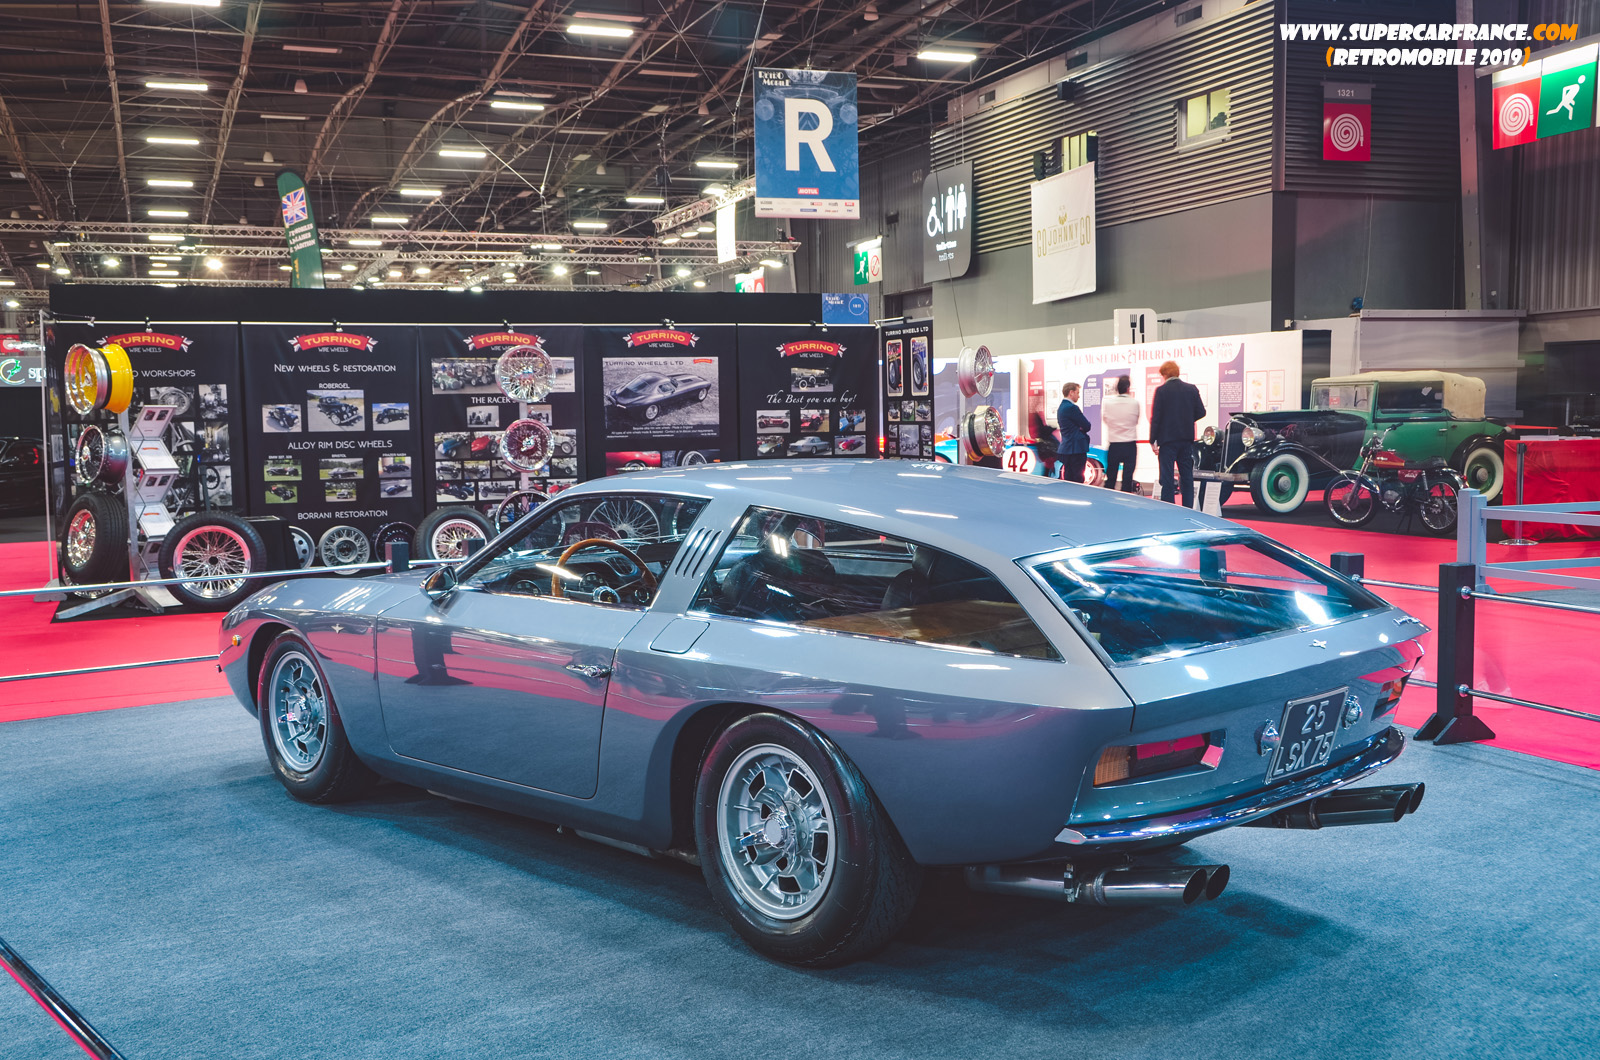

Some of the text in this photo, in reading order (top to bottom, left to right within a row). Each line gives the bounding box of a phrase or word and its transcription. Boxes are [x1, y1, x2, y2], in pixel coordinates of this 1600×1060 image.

[1337, 89, 1355, 97] 1321
[784, 98, 837, 172] R
[1036, 215, 1091, 258] GO JOHNNY GO
[636, 332, 686, 342] TURRINO
[885, 329, 901, 337] TURRINO
[902, 327, 920, 335] WHEELS
[114, 335, 175, 346] TURRINO
[304, 335, 361, 346] TURRINO
[478, 335, 531, 345] TURRINO
[789, 343, 834, 352] TURRINO
[1188, 345, 1214, 358] MANS
[141, 369, 196, 377] WORKSHOPS
[332, 364, 340, 372] &
[343, 364, 397, 372] RESTORATION
[766, 389, 784, 403] The
[785, 393, 804, 403] Best
[800, 398, 820, 409] you
[840, 389, 857, 409] buy!
[287, 440, 393, 450] ALLOY RIM DISC WHEELS
[1008, 451, 1028, 472] 42
[298, 510, 388, 520] BORRANI RESTORATION
[1301, 700, 1330, 735] 25
[1272, 731, 1334, 776] LSX 75
